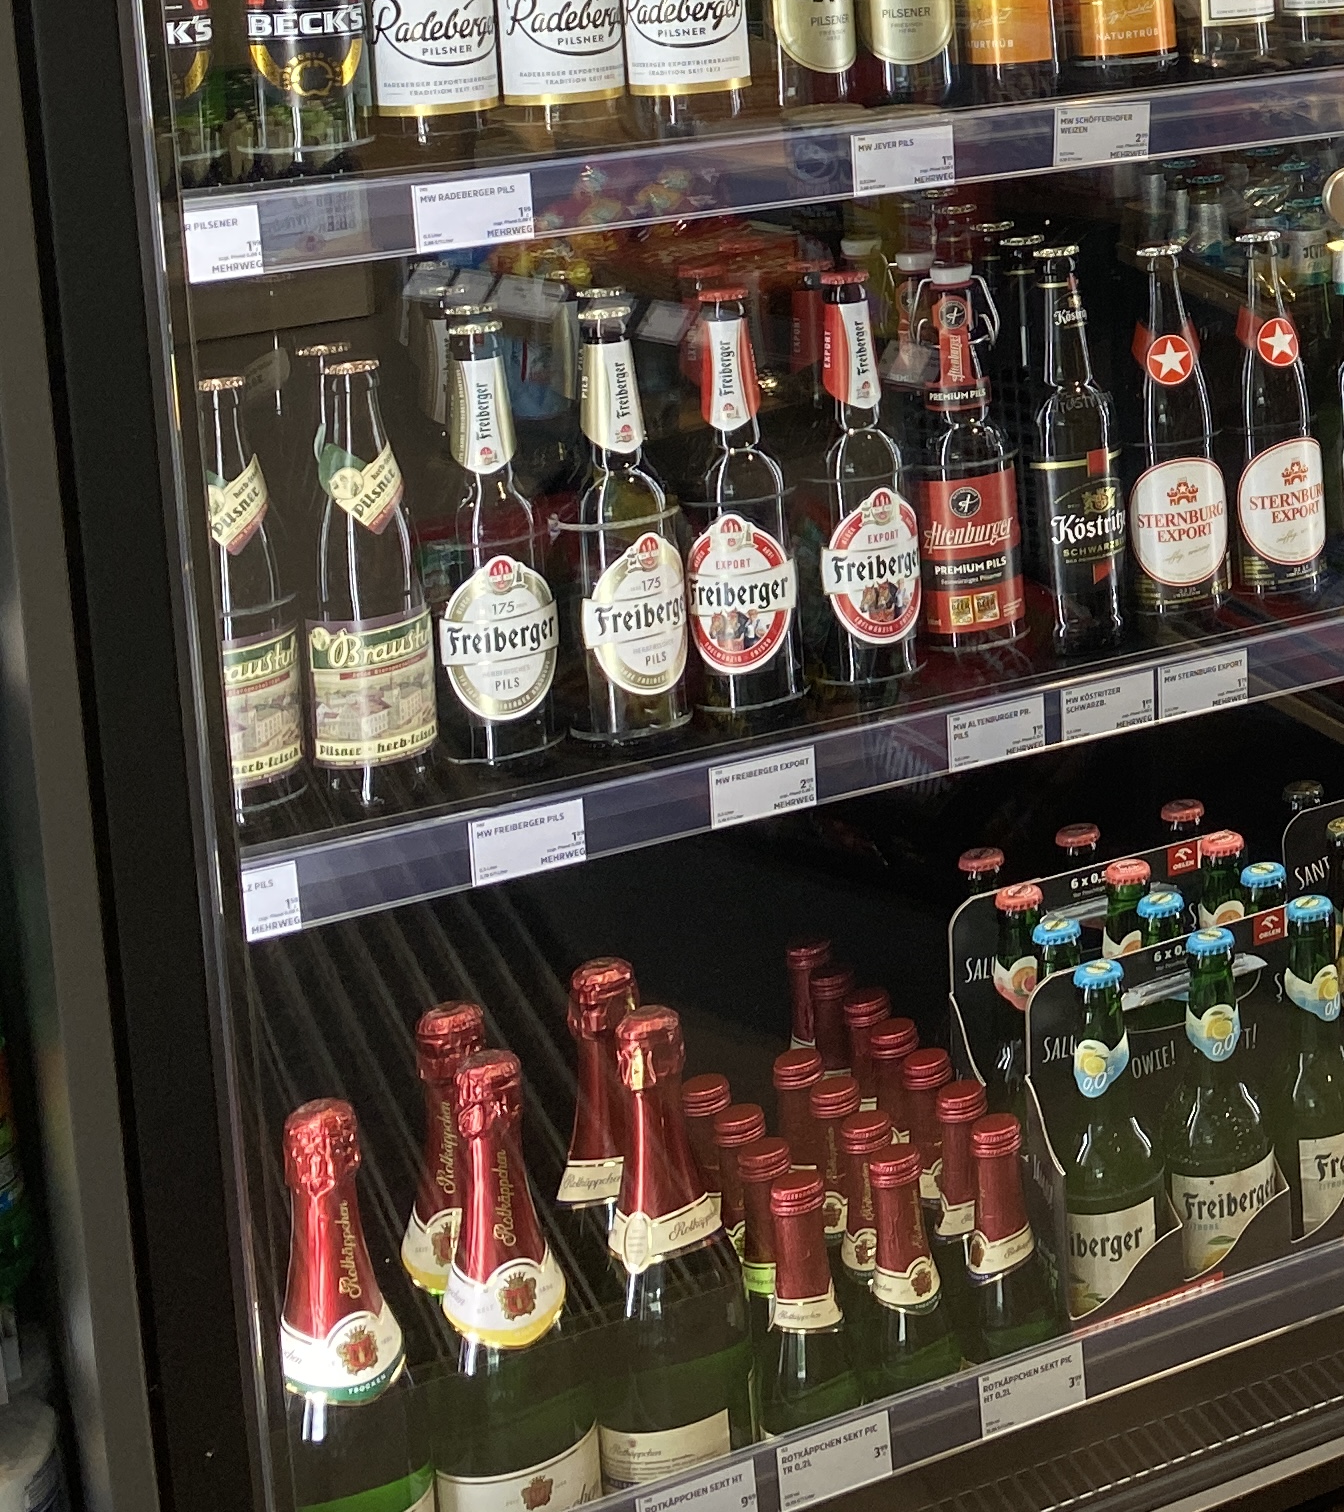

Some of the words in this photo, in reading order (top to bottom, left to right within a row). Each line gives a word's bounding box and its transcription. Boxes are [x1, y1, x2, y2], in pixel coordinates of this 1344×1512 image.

[810, 13, 850, 27] PILSENER
[882, 6, 931, 20] PILSENER
[247, 8, 365, 37] BECK'S
[557, 34, 605, 47] PILSNER
[657, 26, 707, 39] PILSNER
[1096, 27, 1161, 43] NATURTRÜB
[421, 44, 473, 57] PILSNER
[1075, 113, 1133, 125] SCHÖFFERHOFER
[1060, 126, 1088, 135] WEIZEN
[873, 141, 895, 152] JEVER
[897, 138, 915, 149] PILS
[914, 172, 955, 184] MEHRWEG
[420, 194, 434, 205] MW
[437, 187, 494, 202] RADEBERGER
[496, 185, 516, 197] PILS
[193, 217, 239, 232] PILSENER
[487, 224, 533, 239] MEHRWEG
[212, 260, 263, 276] MEHRWEG
[476, 381, 493, 441] Freiberger
[1137, 502, 1224, 530] STERNBURG
[1271, 501, 1320, 524] EXPORT
[867, 530, 899, 544] EXPORT
[1157, 522, 1213, 544] EXPORT
[715, 558, 751, 571] EXPORT
[831, 550, 919, 583] Freiberger
[934, 562, 980, 575] PREMIUM
[982, 556, 1007, 570] PILS
[447, 611, 558, 658] Freiberger
[645, 651, 667, 665] PILS
[1178, 666, 1213, 680] STERNBURG
[1214, 659, 1243, 672] EXPORT
[494, 676, 521, 691] PILS
[967, 713, 1013, 729] ALTENBURGER
[493, 817, 545, 835] FREIBERGER
[545, 813, 566, 825] PILS
[541, 846, 586, 866] MEHRWEG
[338, 1199, 361, 1300] Rotkäppchen
[982, 1370, 1038, 1393] ROTKÄPPCHEN
[1039, 1362, 1058, 1376] SEKT
[781, 1436, 842, 1464] ROTKÄPPCHEN
[843, 1429, 864, 1444] SEKT
